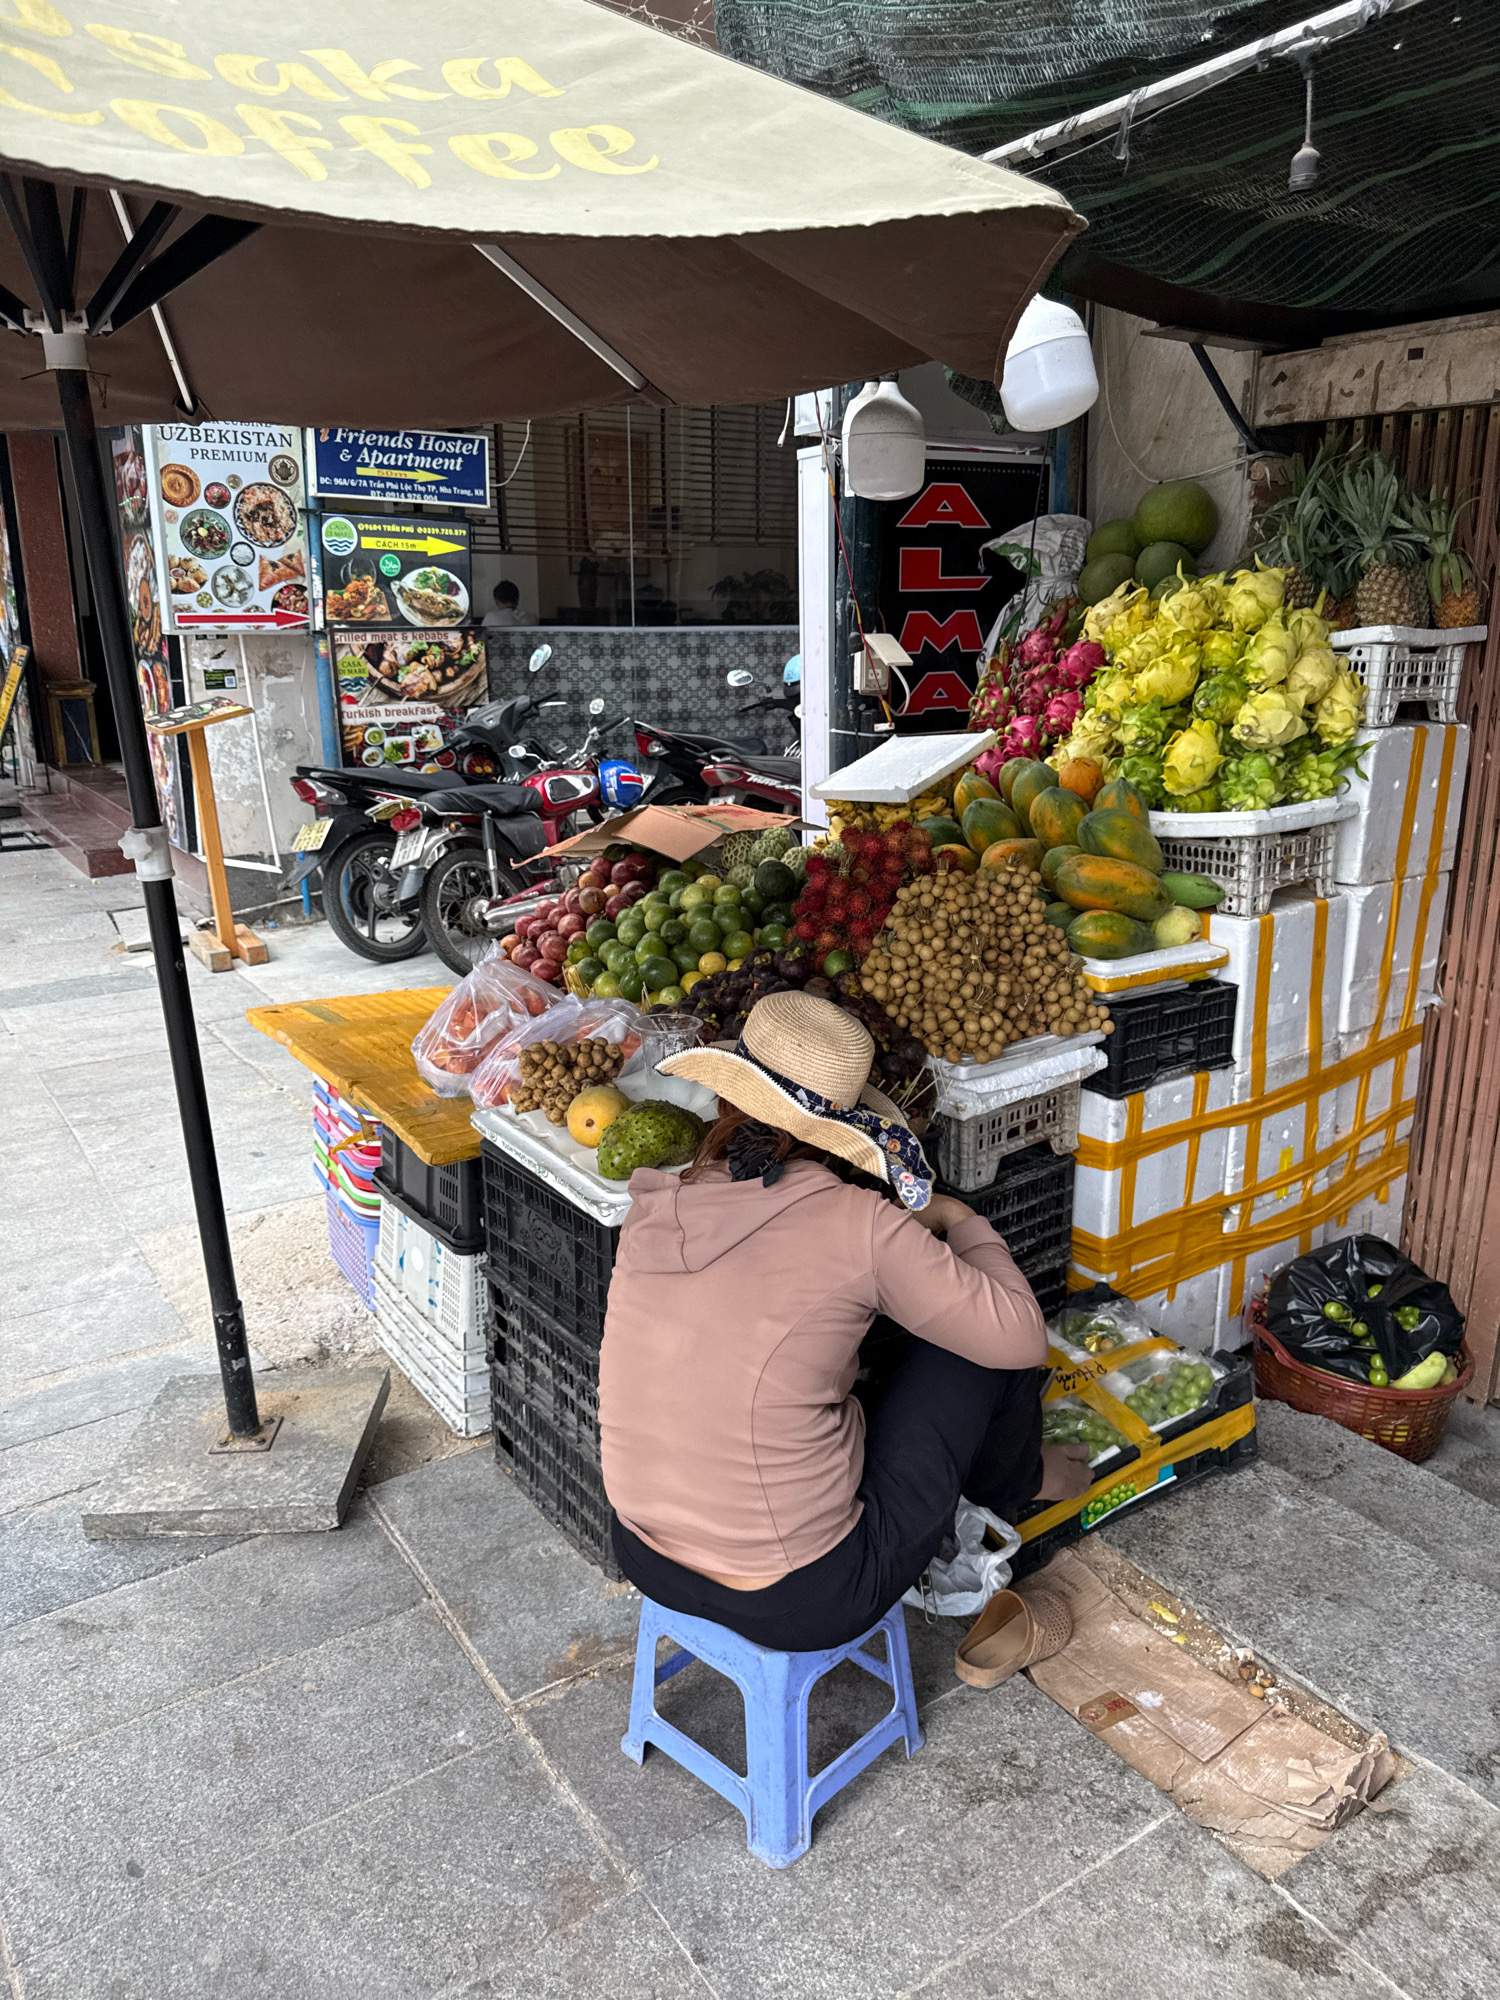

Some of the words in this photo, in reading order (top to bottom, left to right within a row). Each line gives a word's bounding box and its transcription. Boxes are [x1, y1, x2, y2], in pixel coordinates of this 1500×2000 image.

[160, 425, 293, 448] UZBEKISTAN
[334, 427, 414, 450] Friends
[417, 434, 480, 456] Hostel
[190, 448, 268, 463] PREMIUM
[339, 448, 352, 462] &
[356, 446, 464, 471] Apartment
[377, 469, 408, 479] 50m
[474, 488, 484, 497] KH
[371, 632, 398, 641] meat
[401, 632, 408, 641] &
[412, 630, 449, 641] kebabs
[341, 660, 361, 668] CASA
